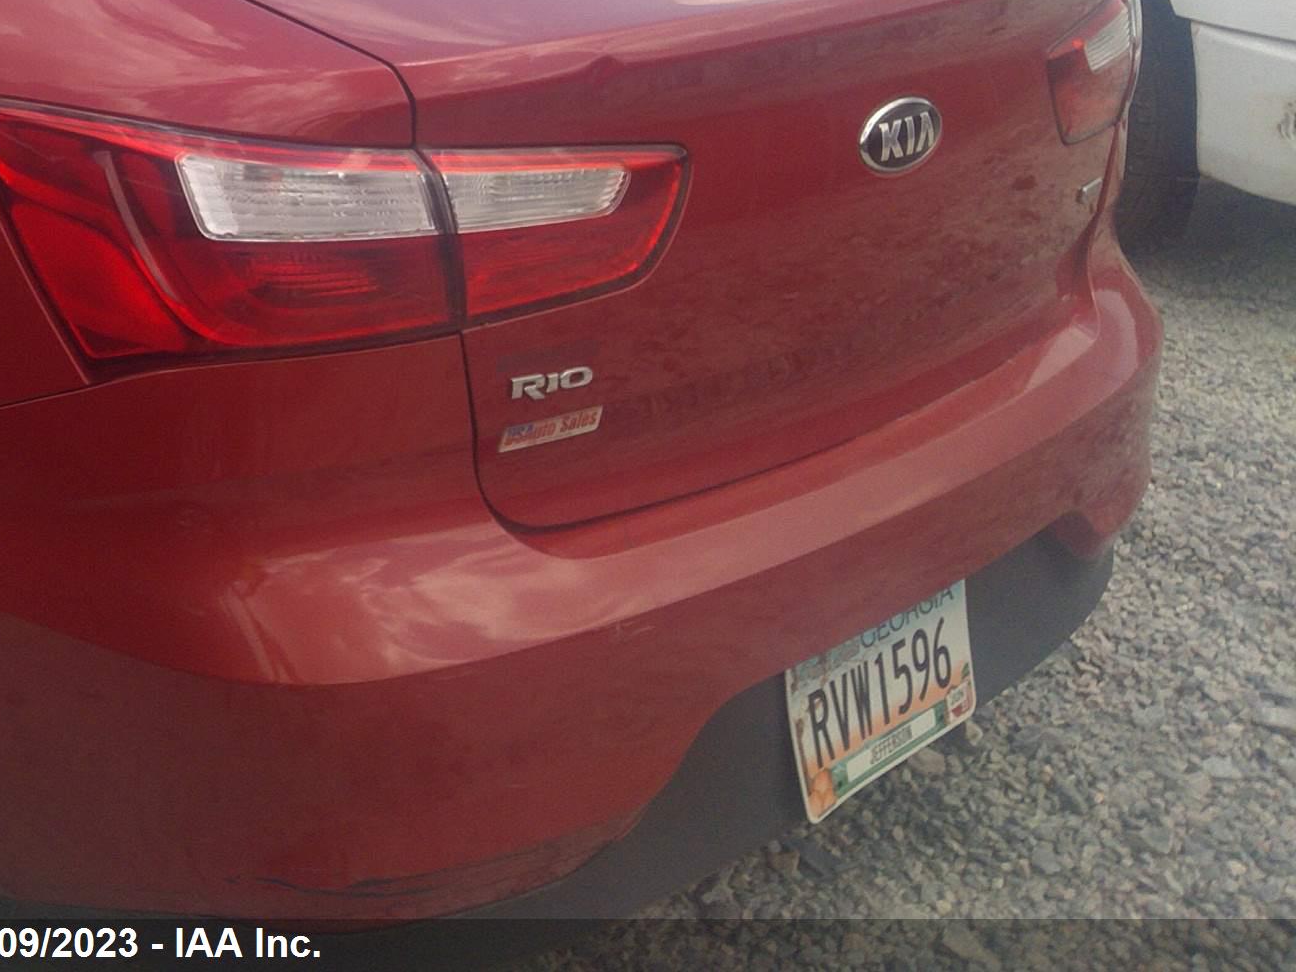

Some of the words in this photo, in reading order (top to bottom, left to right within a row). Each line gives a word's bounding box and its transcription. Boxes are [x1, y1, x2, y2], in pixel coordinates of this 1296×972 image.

[878, 111, 935, 162] KIA
[510, 366, 593, 401] RIO
[559, 410, 599, 433] Sales
[807, 616, 952, 770] RVW1596
